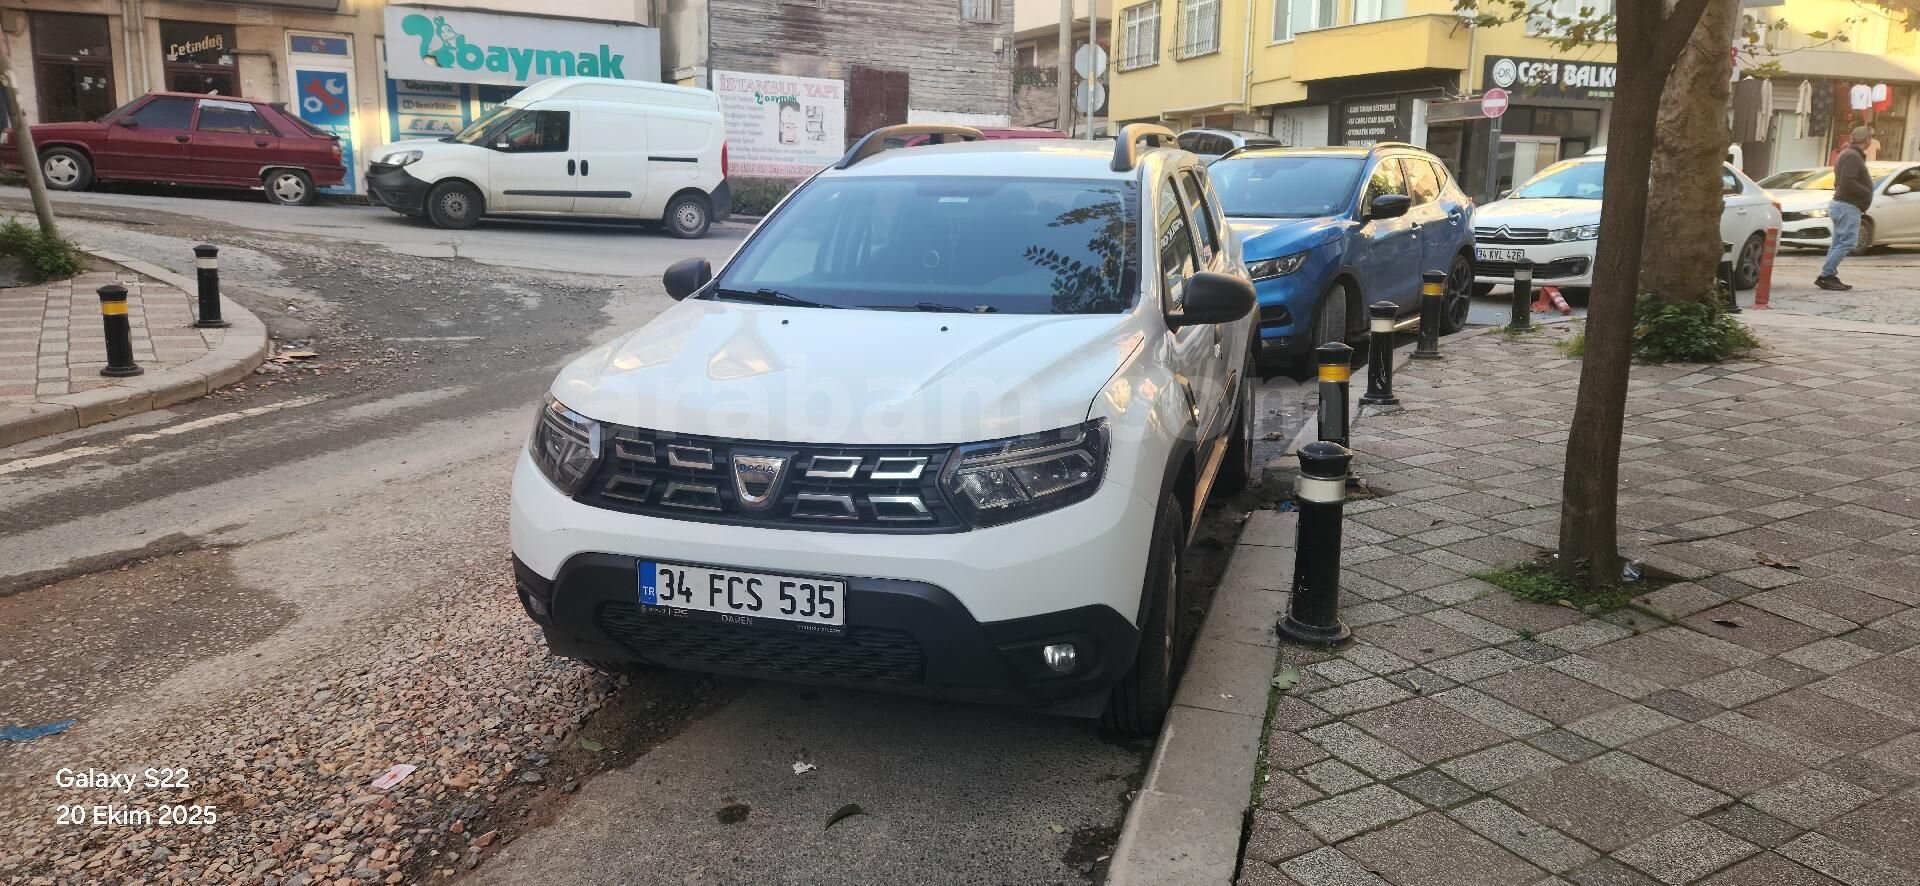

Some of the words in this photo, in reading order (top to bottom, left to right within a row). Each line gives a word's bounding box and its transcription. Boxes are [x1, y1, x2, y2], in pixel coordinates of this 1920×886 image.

[455, 34, 625, 81] baymak
[719, 74, 801, 97] İSTANBUL
[764, 94, 797, 104] baymak
[738, 464, 775, 474] DACIA
[642, 585, 655, 596] TR
[658, 568, 693, 603] 34
[708, 573, 763, 611] FCS
[779, 580, 836, 619] 535
